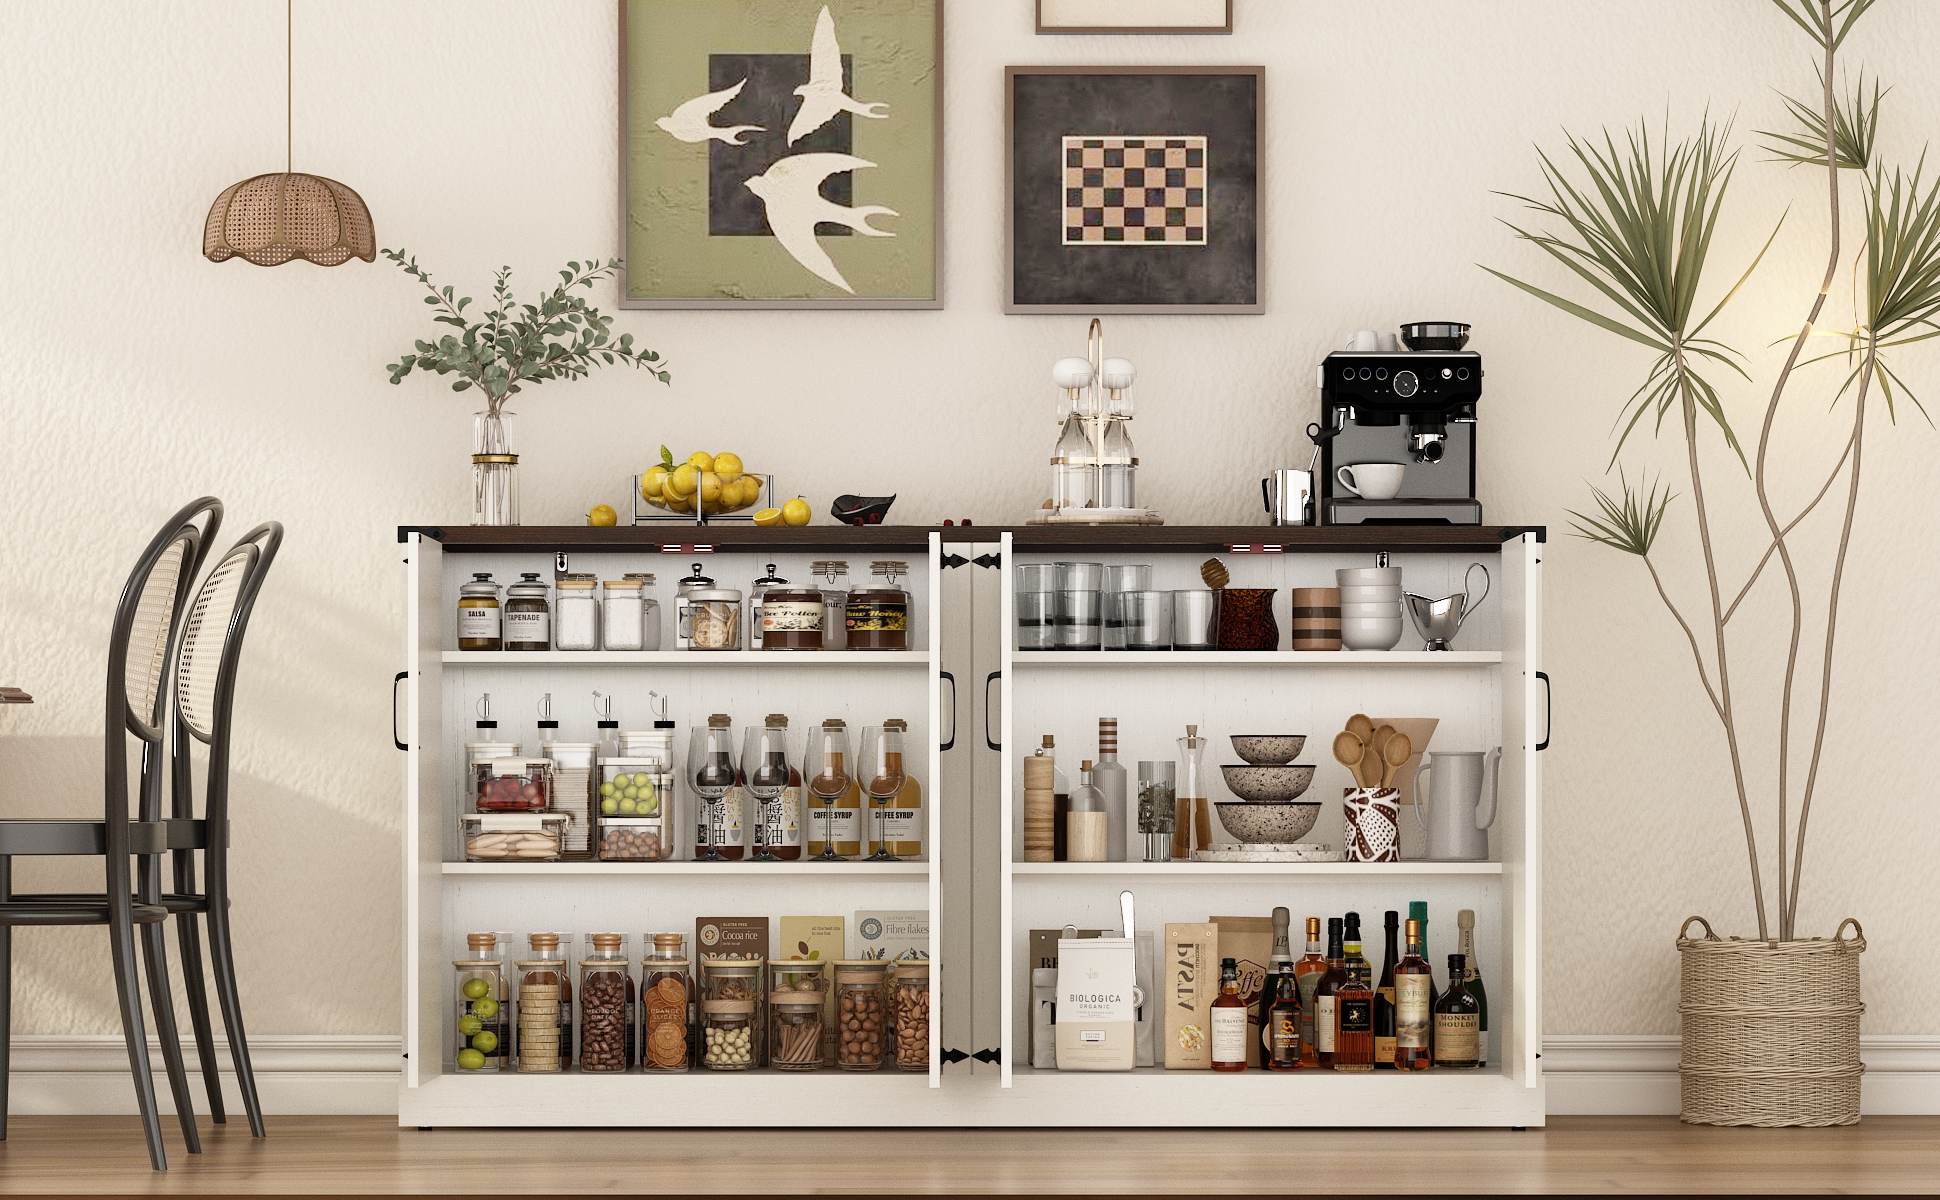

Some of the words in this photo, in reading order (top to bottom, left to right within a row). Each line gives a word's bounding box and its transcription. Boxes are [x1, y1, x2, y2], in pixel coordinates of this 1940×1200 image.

[886, 924, 906, 934] Fibre
[722, 930, 744, 940] Cocoa
[745, 930, 758, 940] rice
[1070, 994, 1121, 1002] BIOLOGICA
